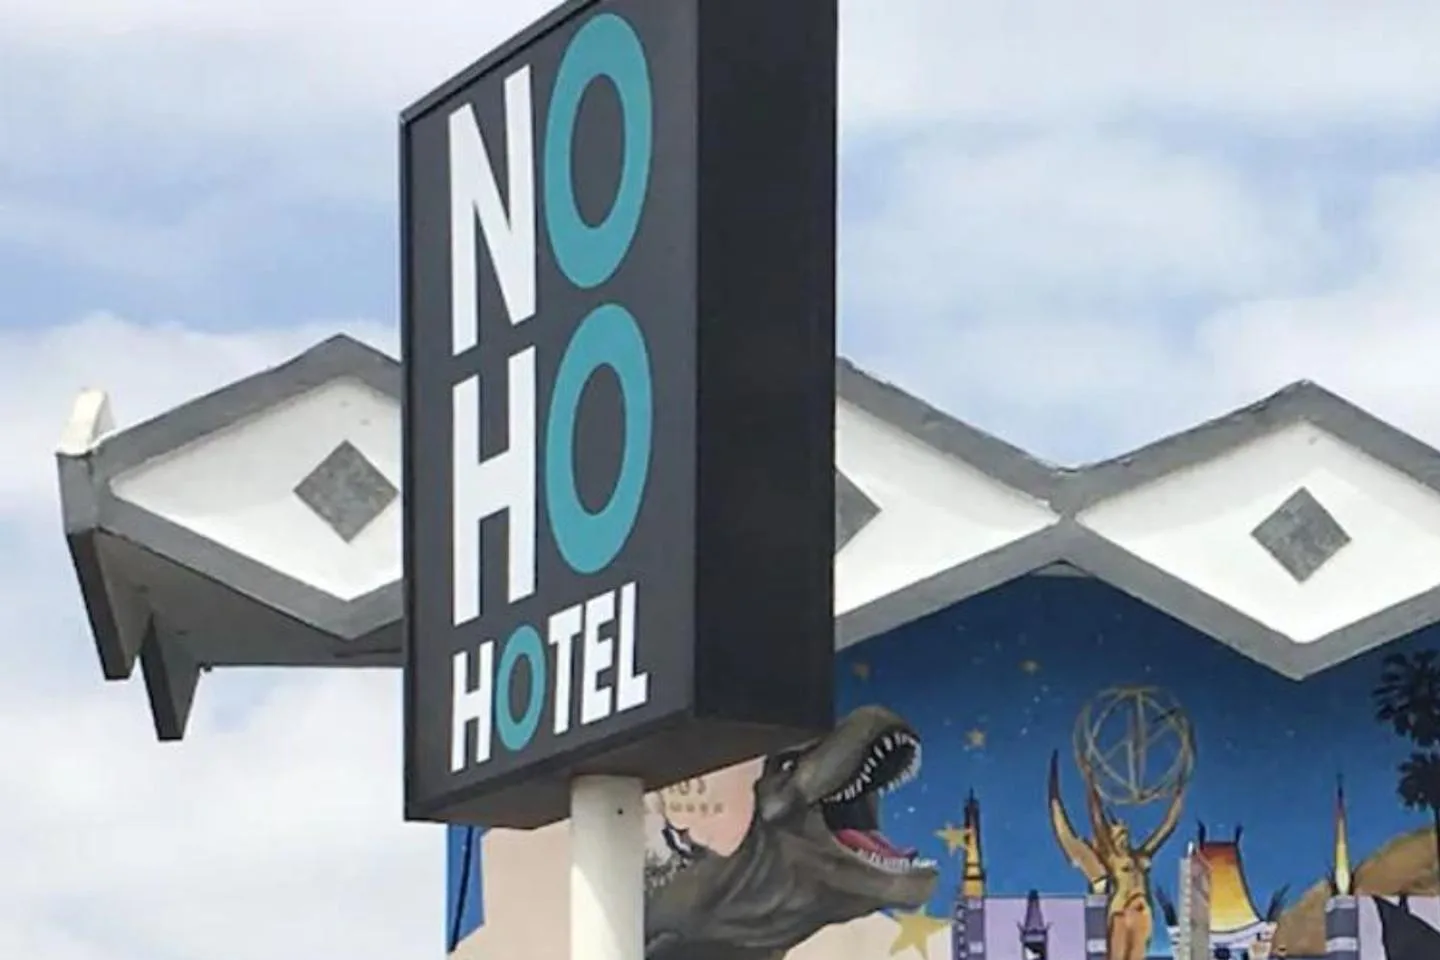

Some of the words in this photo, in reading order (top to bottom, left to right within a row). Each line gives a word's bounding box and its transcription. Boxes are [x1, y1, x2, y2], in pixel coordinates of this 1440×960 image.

[449, 13, 652, 356] NO
[452, 303, 653, 627] HO
[450, 581, 649, 773] HOTEL
